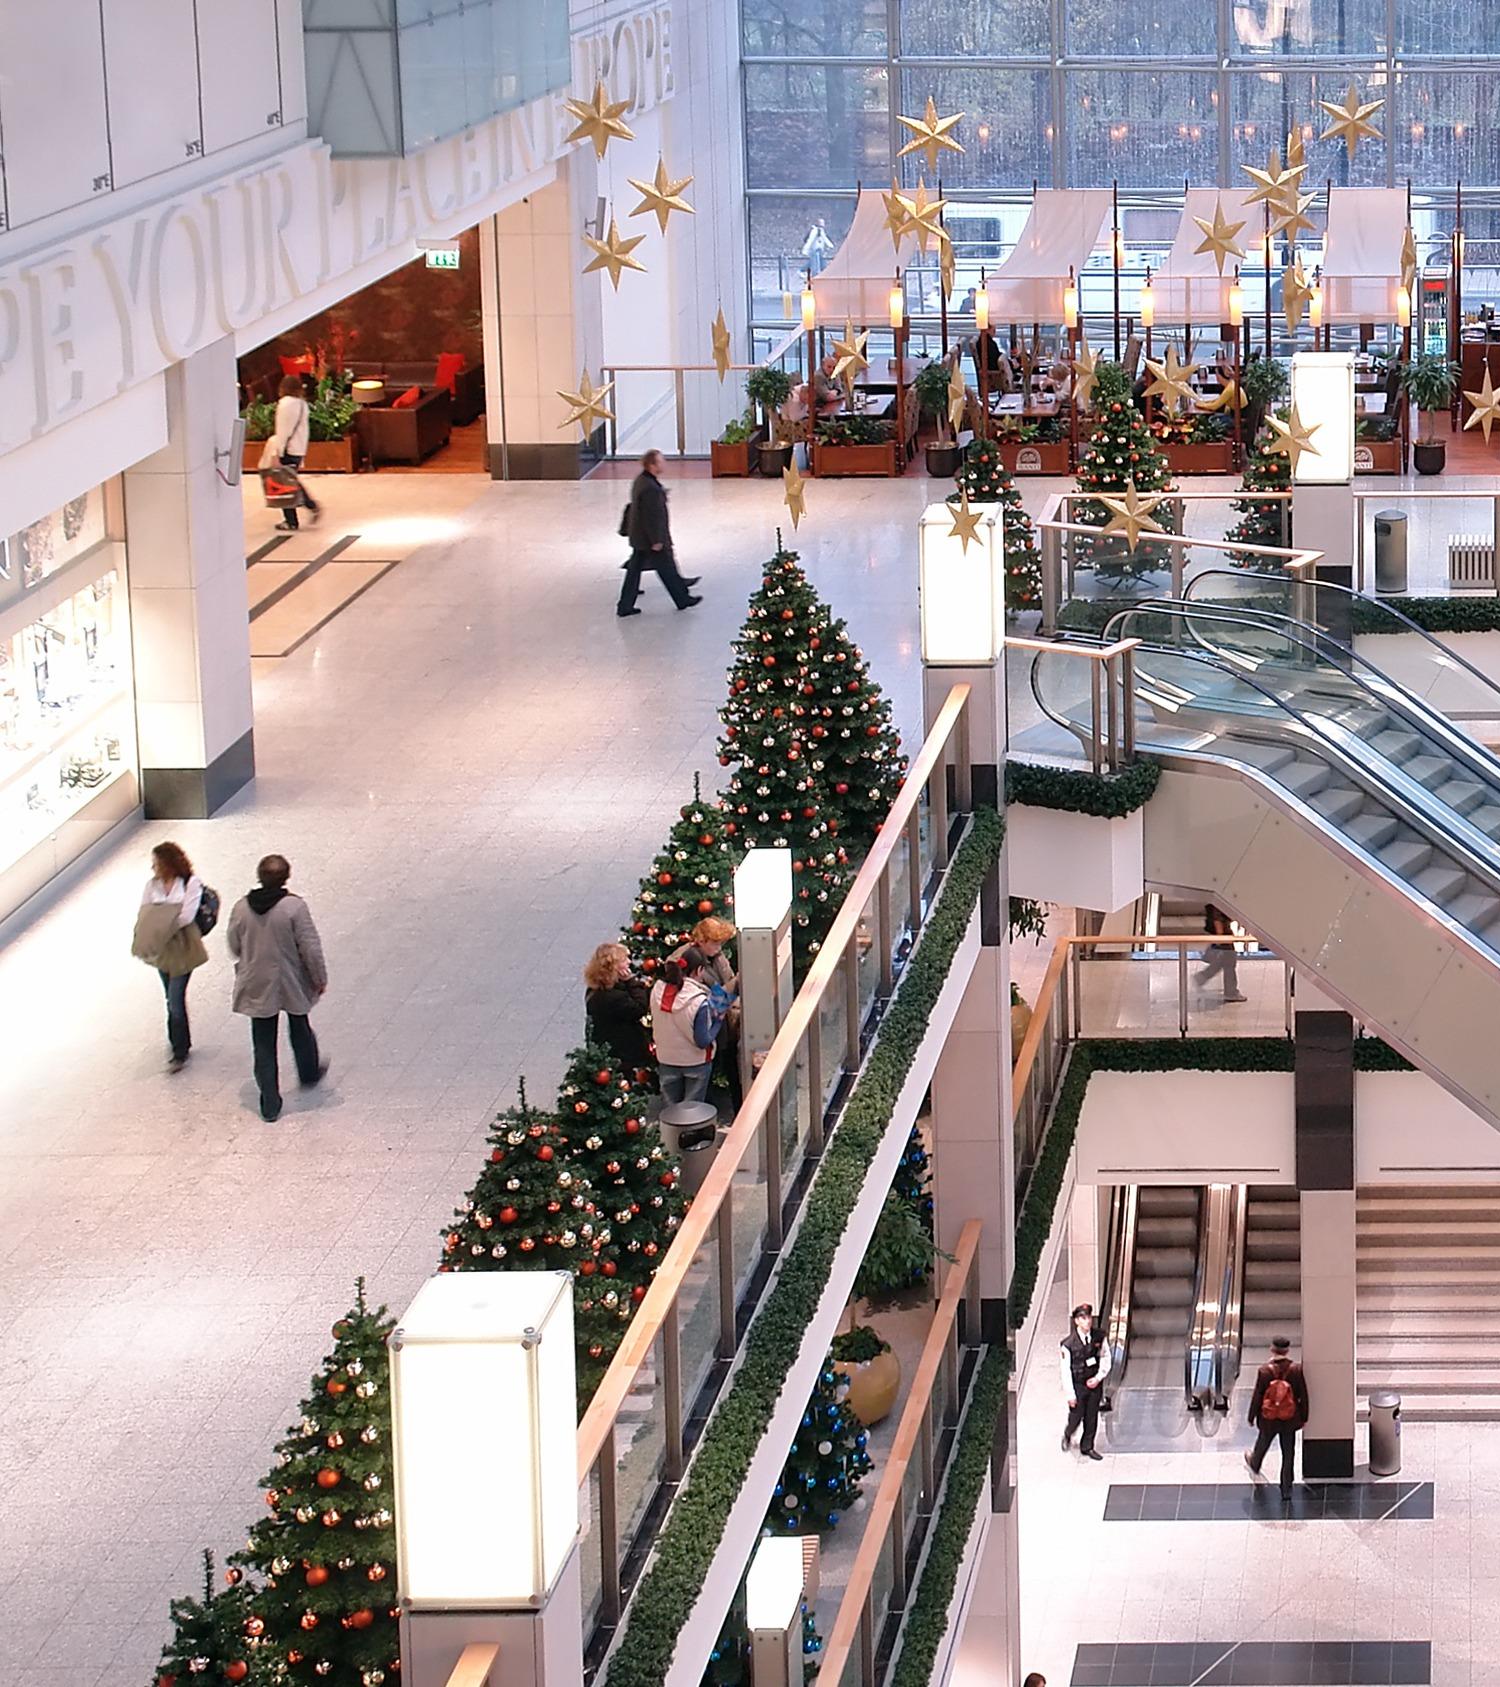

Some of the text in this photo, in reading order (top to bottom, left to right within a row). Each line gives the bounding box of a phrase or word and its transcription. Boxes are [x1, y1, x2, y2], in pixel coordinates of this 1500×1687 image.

[91, 163, 302, 394] YOUR
[308, 128, 483, 287] PLACE
[486, 100, 539, 203] IN
